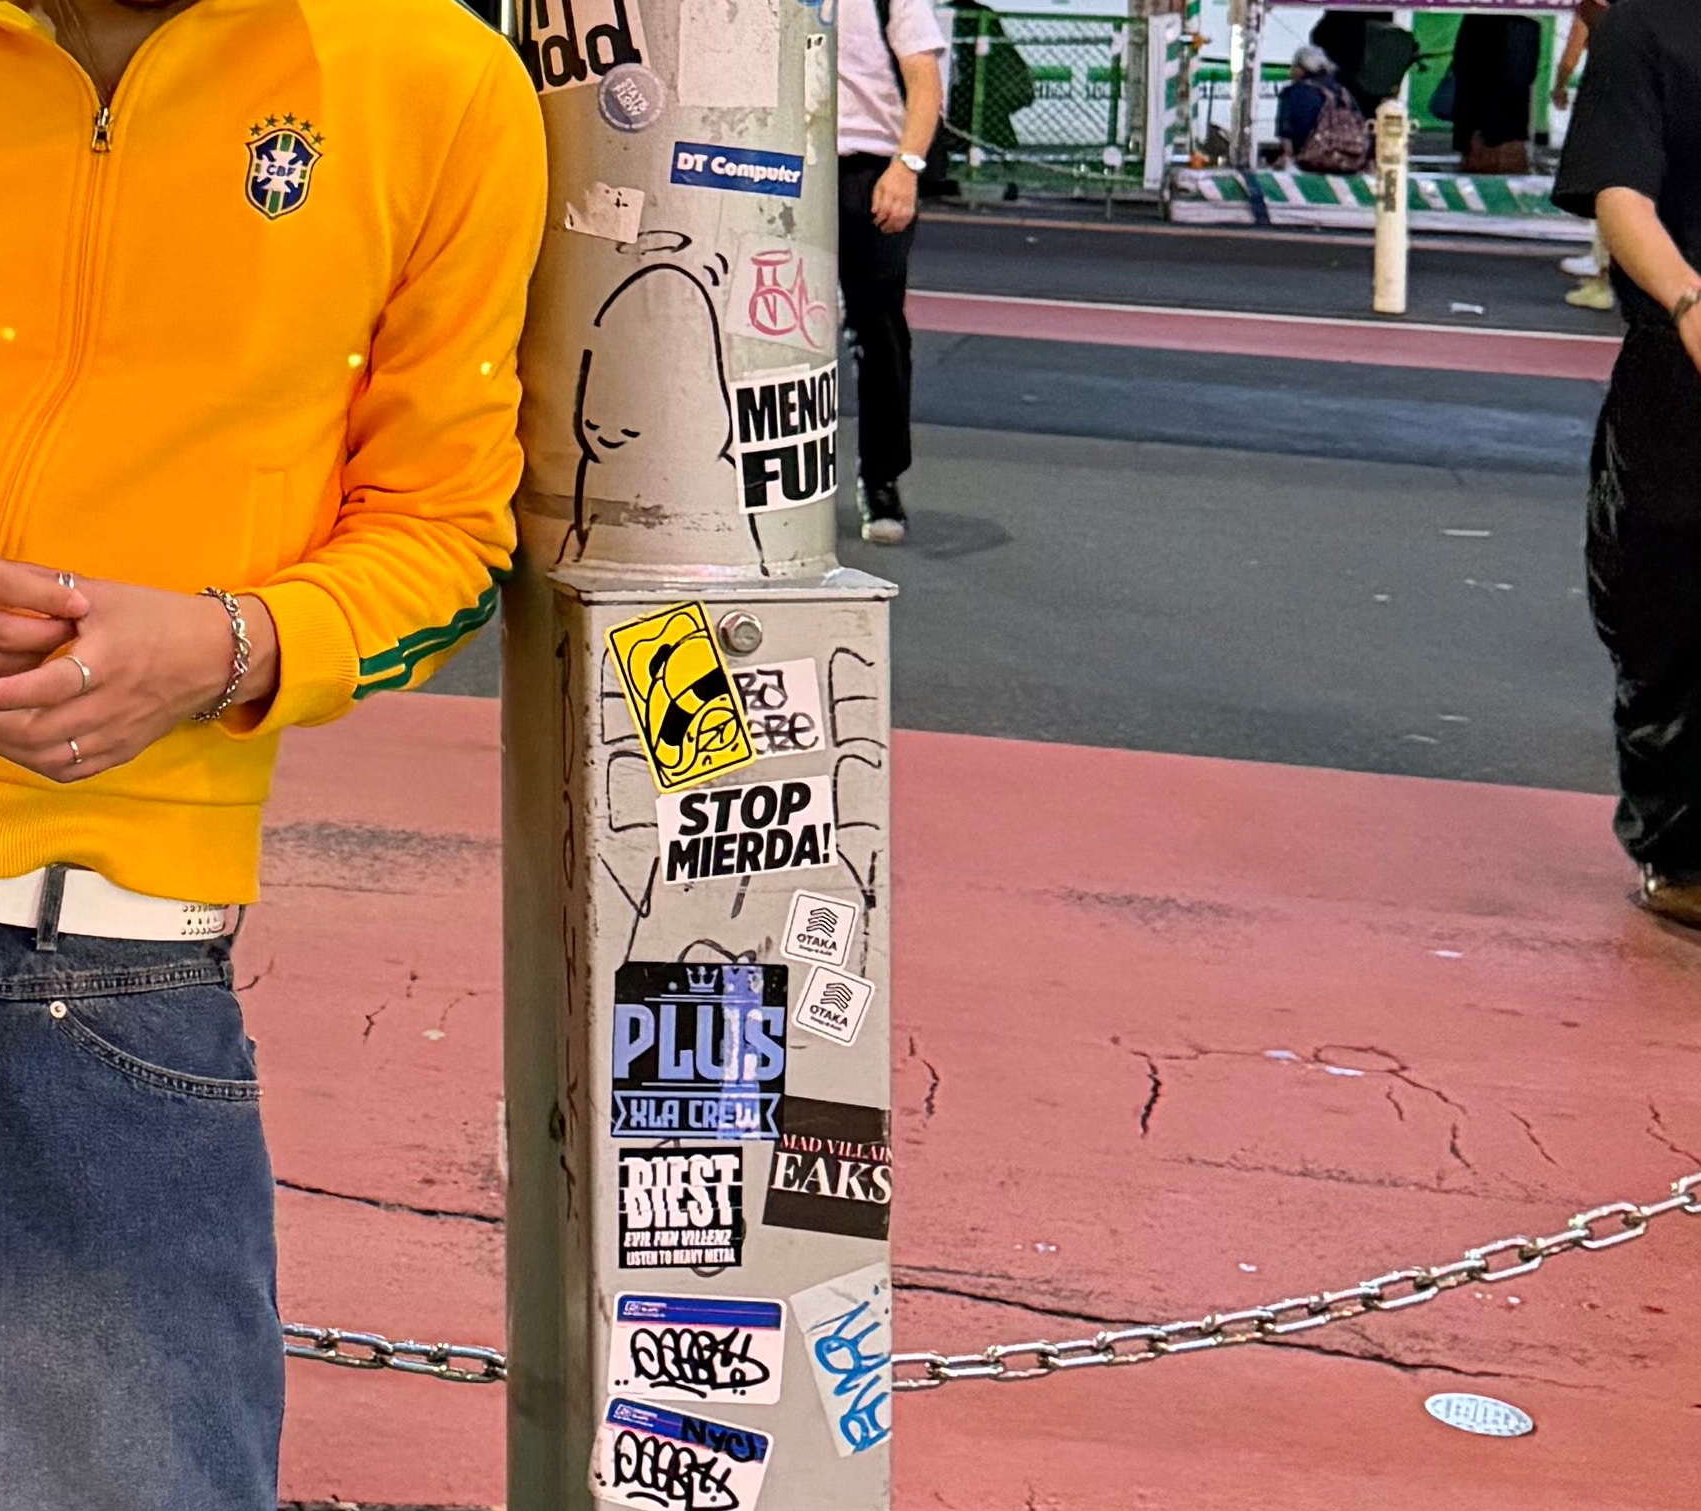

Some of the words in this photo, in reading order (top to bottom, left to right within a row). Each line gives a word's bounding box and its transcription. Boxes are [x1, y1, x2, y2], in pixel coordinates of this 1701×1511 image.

[676, 152, 708, 172] DT
[710, 156, 801, 184] Computer
[677, 781, 812, 837] STOP
[665, 822, 832, 883] MIERDA!
[796, 933, 838, 952] OTAKA
[809, 1003, 848, 1028] OTAKA
[614, 1003, 787, 1082] PLUS
[688, 1096, 761, 1130] CREW
[782, 1133, 822, 1153] MAD
[826, 1138, 894, 1163] VILLAIN
[622, 1153, 740, 1229] BIEST
[770, 1151, 894, 1205] EAKS
[623, 1231, 651, 1248] EVIL
[626, 1250, 658, 1266] LISTEN
[659, 1249, 672, 1265] TO
[673, 1248, 703, 1265] HEAVY
[704, 1247, 736, 1264] METAL
